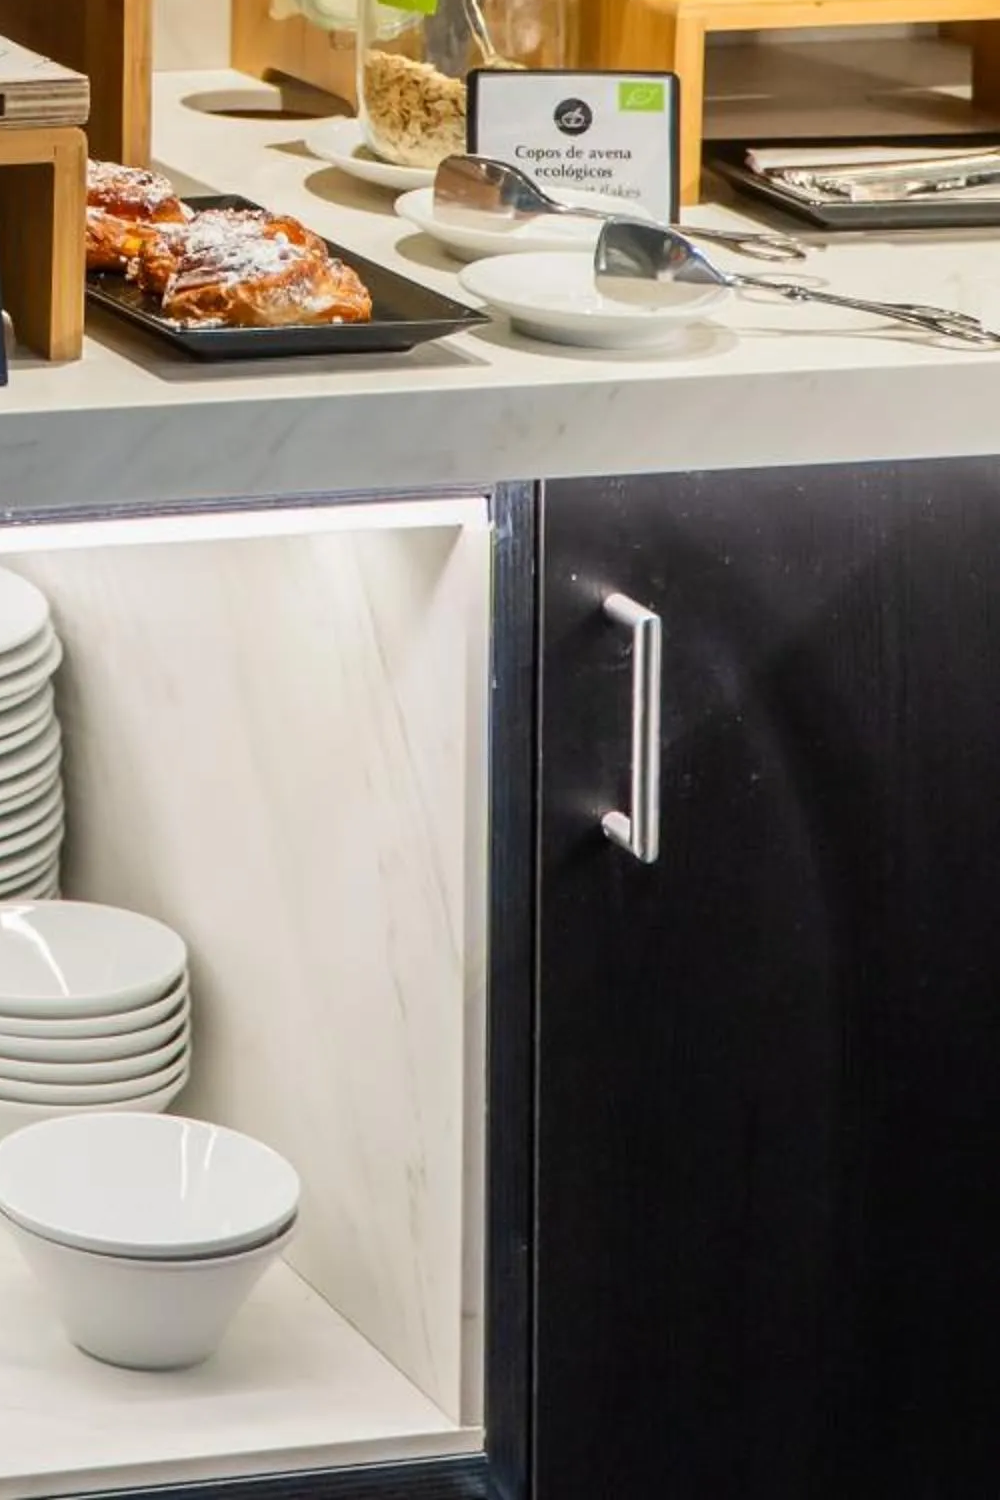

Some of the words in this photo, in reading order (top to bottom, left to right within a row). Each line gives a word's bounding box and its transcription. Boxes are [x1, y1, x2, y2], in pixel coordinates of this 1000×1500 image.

[514, 145, 561, 161] Copos
[565, 145, 584, 160] de
[588, 148, 632, 161] avena
[534, 163, 613, 181] ecológicos
